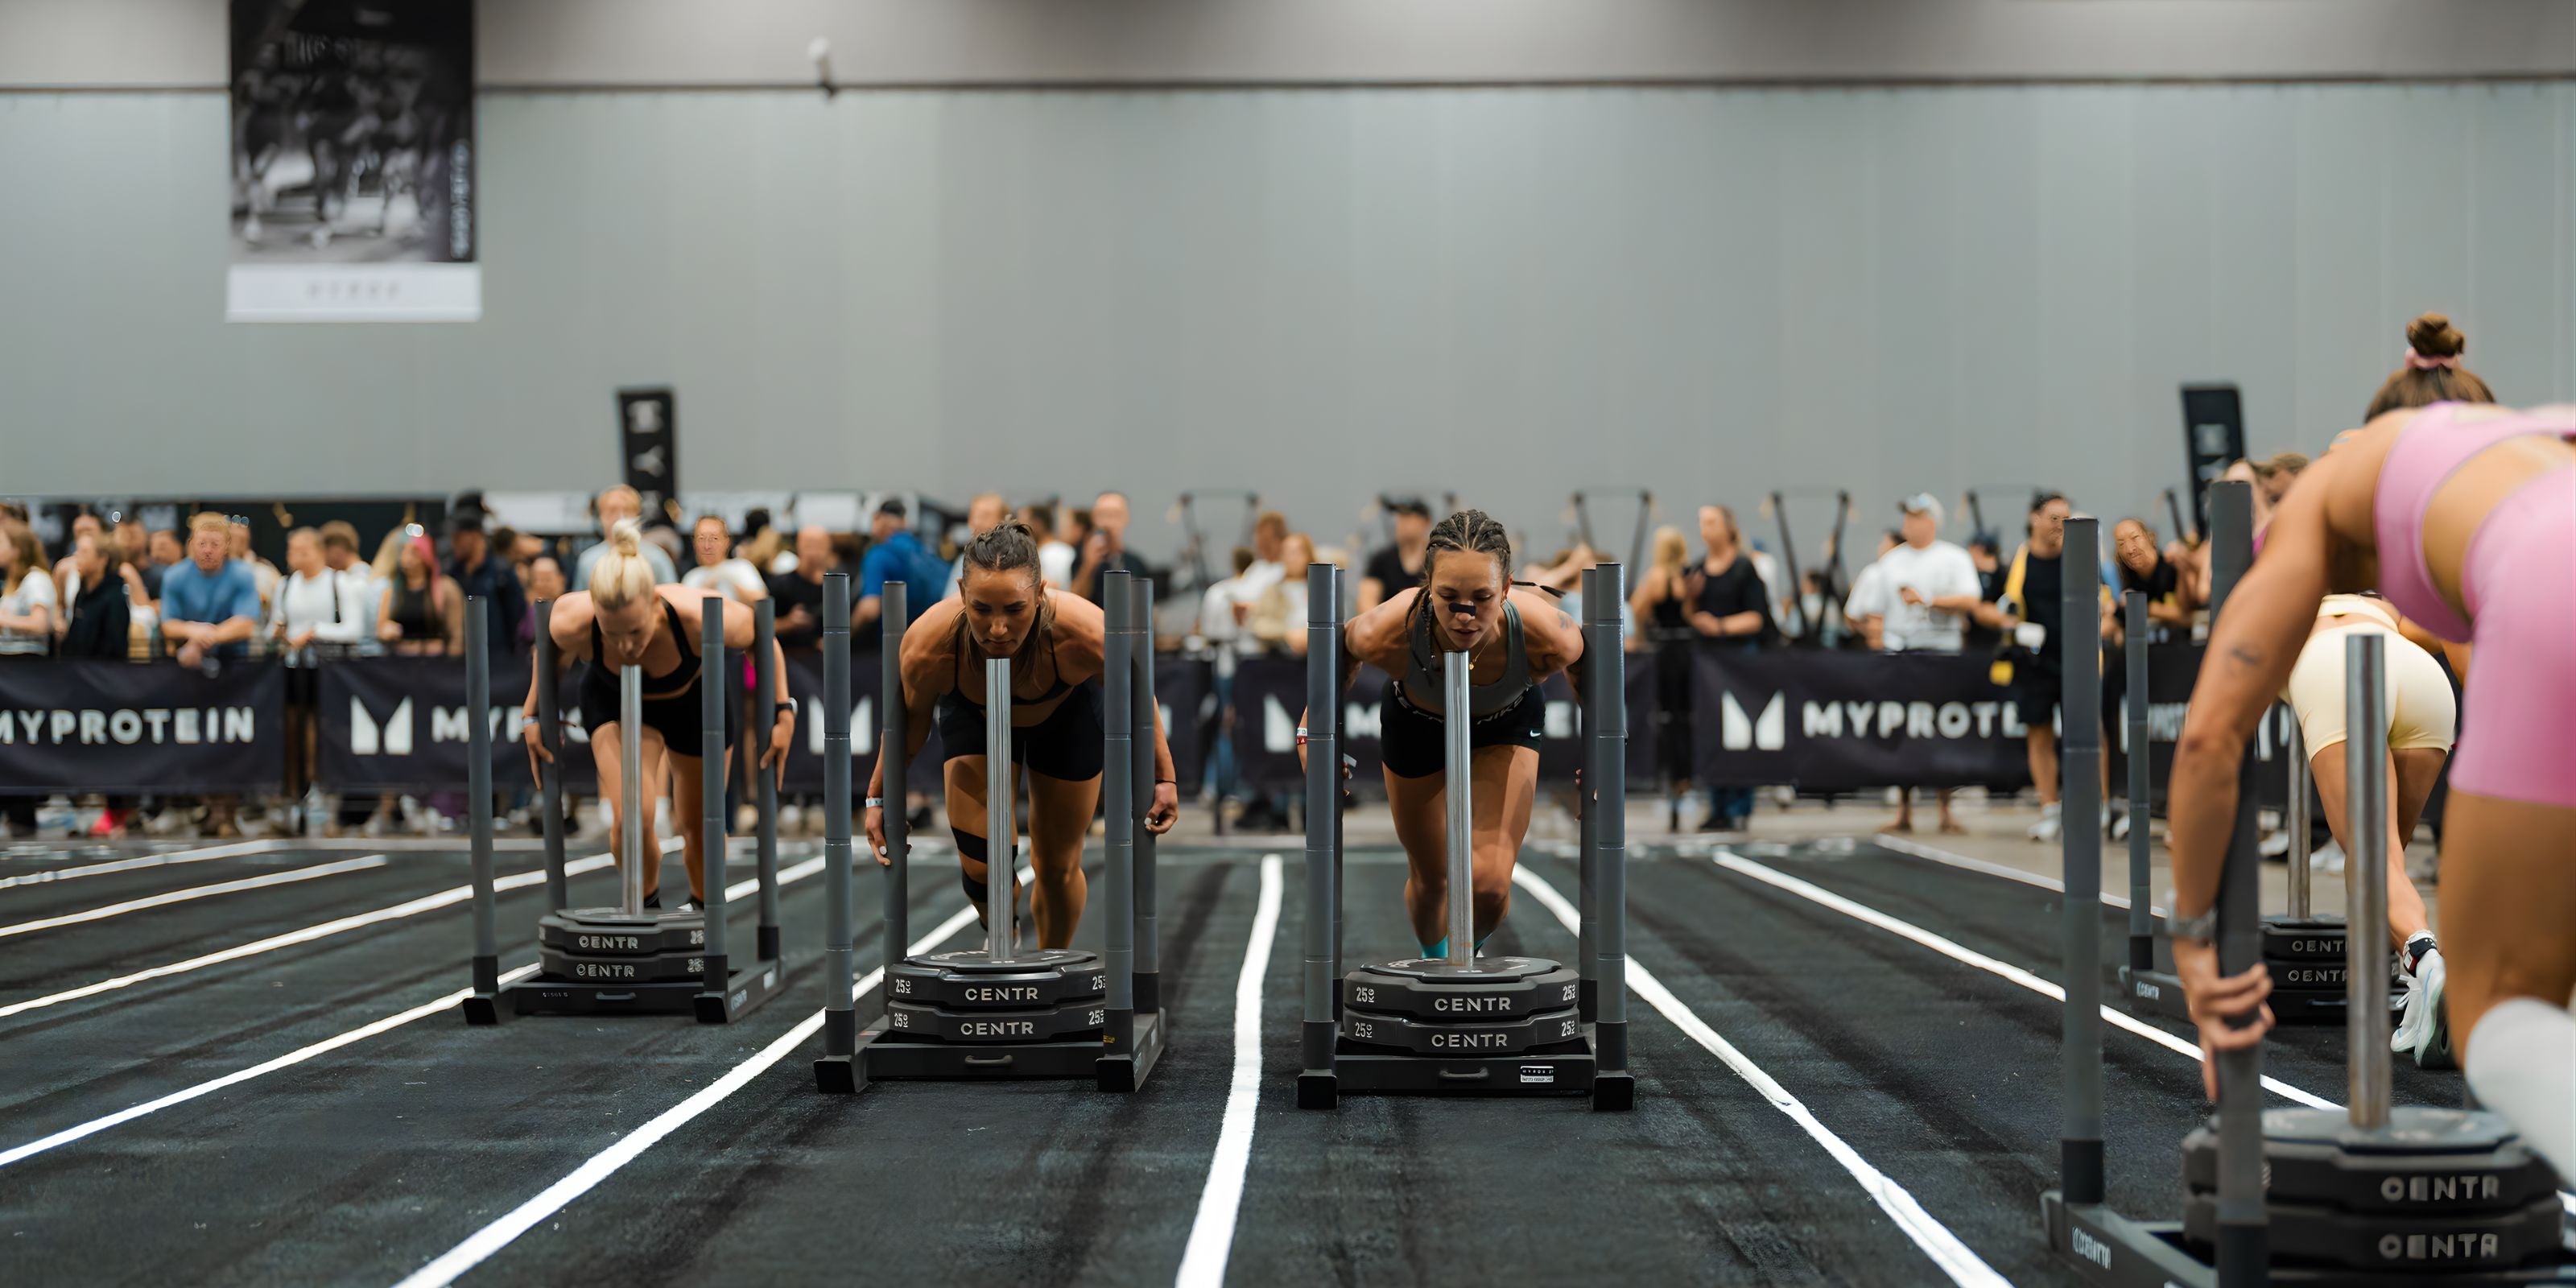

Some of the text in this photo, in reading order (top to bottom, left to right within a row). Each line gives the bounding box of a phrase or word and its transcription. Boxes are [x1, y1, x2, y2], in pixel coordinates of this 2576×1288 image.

[2292, 940, 2348, 952] CENT
[964, 987, 1038, 1001] CENTR
[1435, 997, 1511, 1012] CENTR
[960, 1022, 1034, 1035] CENTR
[1431, 1034, 1508, 1047] CENTR
